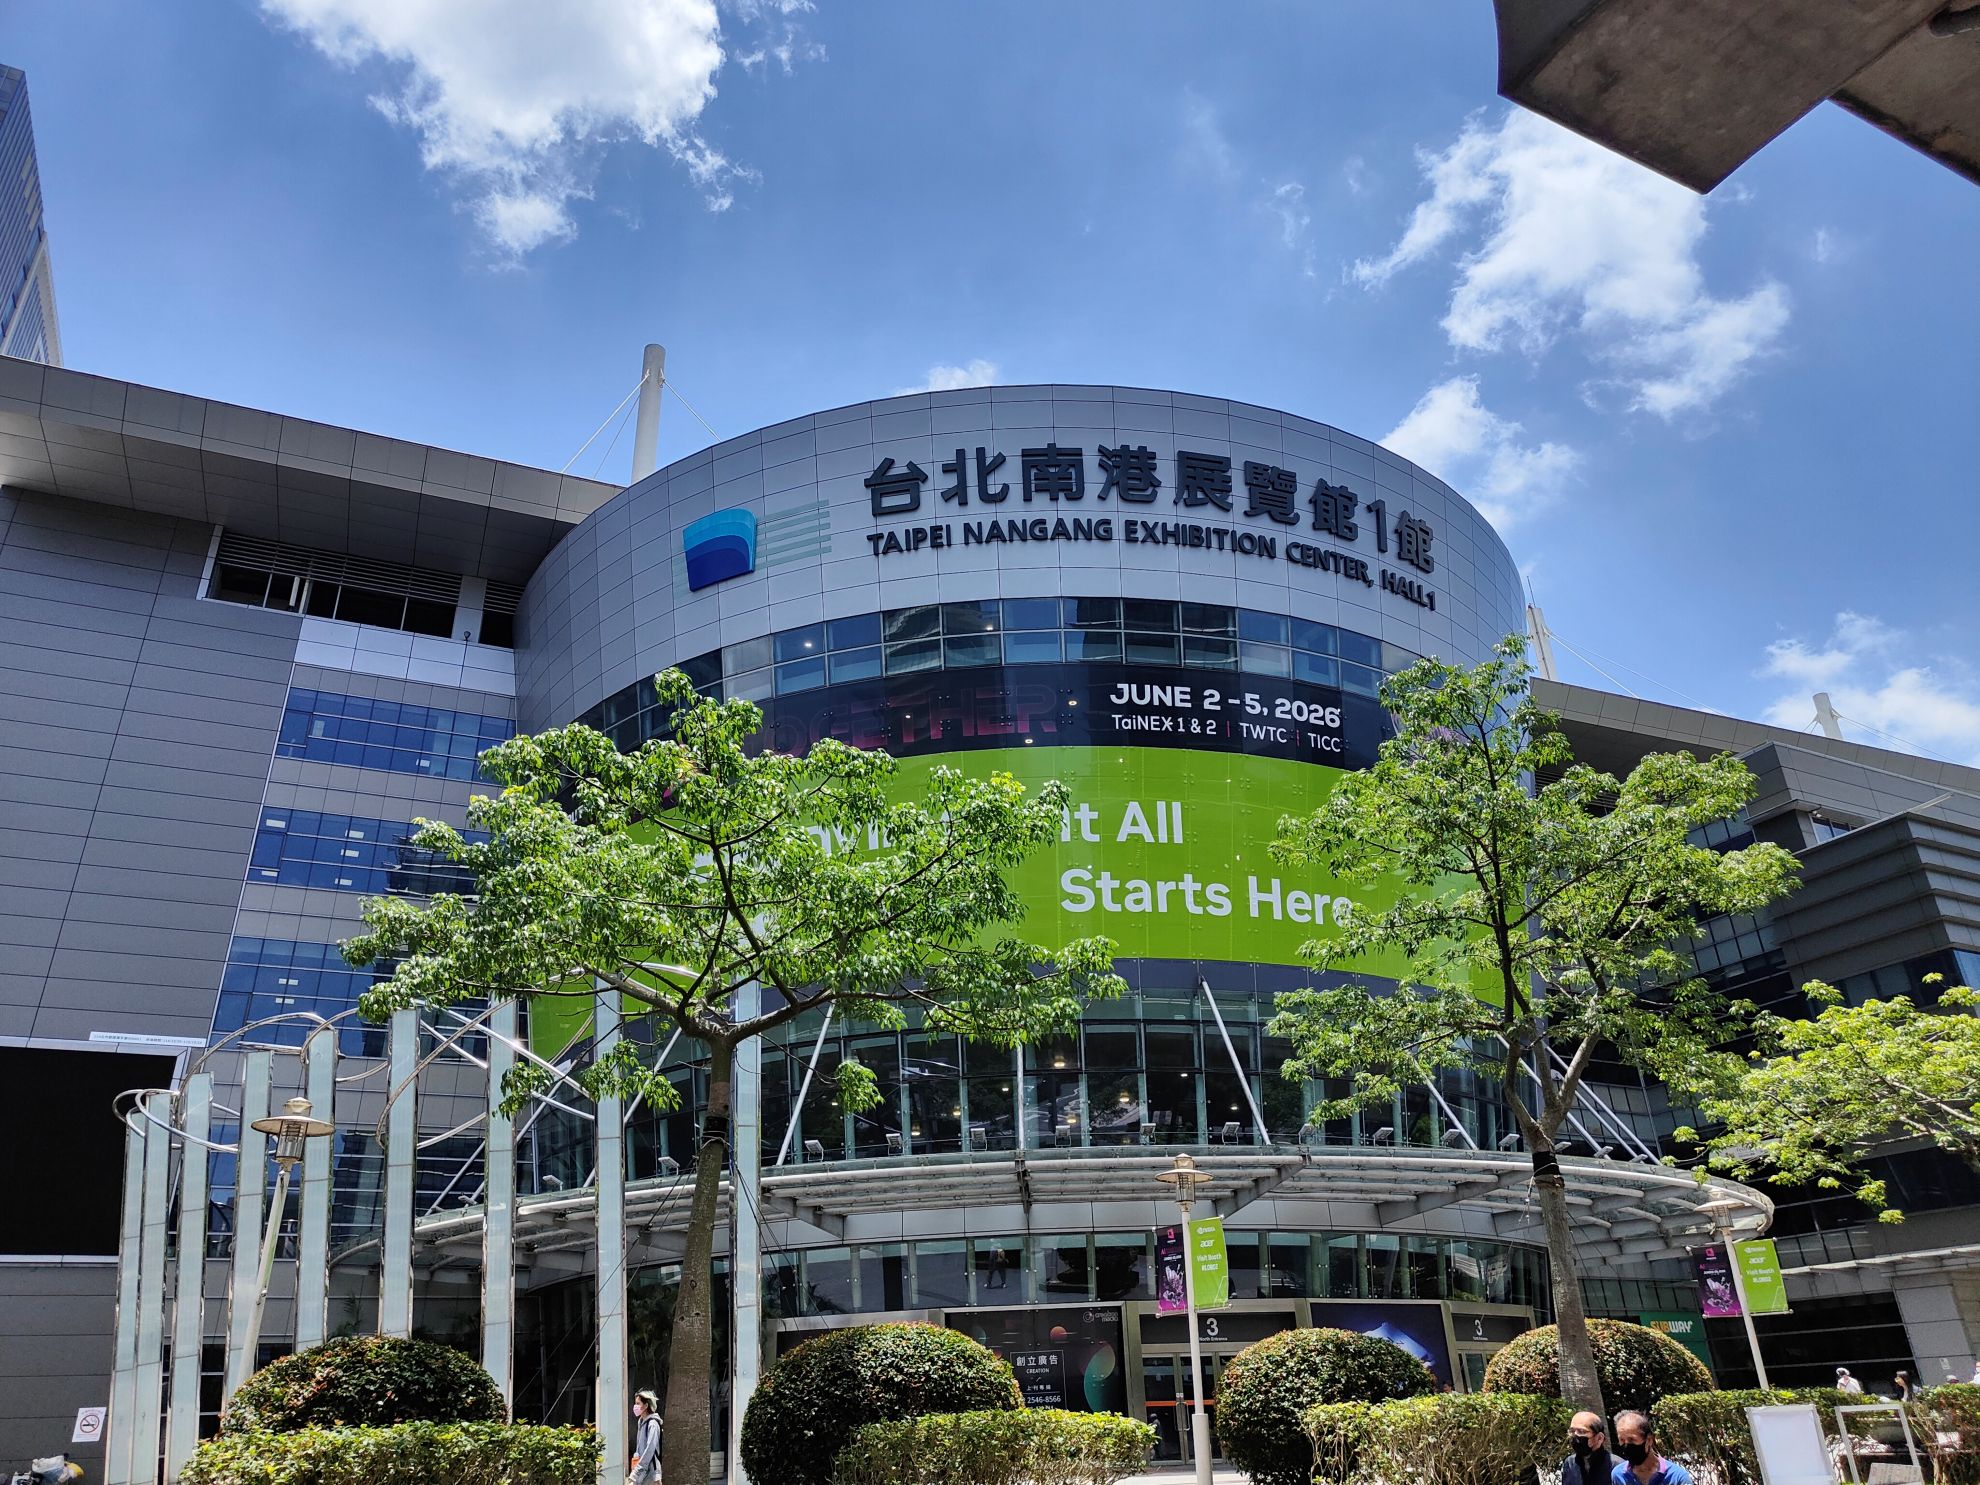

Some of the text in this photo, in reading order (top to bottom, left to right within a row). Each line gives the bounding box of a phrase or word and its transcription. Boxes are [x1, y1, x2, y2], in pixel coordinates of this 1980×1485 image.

[864, 442, 1435, 574] 台北南港展覽館1館
[866, 524, 951, 556] TAIPEI
[963, 517, 1113, 546] NANGANG
[1124, 518, 1277, 559] EXHIBITION
[1286, 541, 1375, 588] CENTER,
[1381, 568, 1428, 608] HALL
[1109, 683, 1192, 708] JUNE
[1275, 697, 1342, 729] 2026
[1111, 714, 1342, 753] TaiNEX 1 & 2 TWTC TICC
[1116, 800, 1184, 844] All
[1060, 868, 1233, 917] Starts
[1206, 1317, 1219, 1336] 3
[1474, 1319, 1483, 1336] 3
[1650, 1320, 1692, 1333] SUBWAY
[1016, 1354, 1059, 1367] 創立廣告
